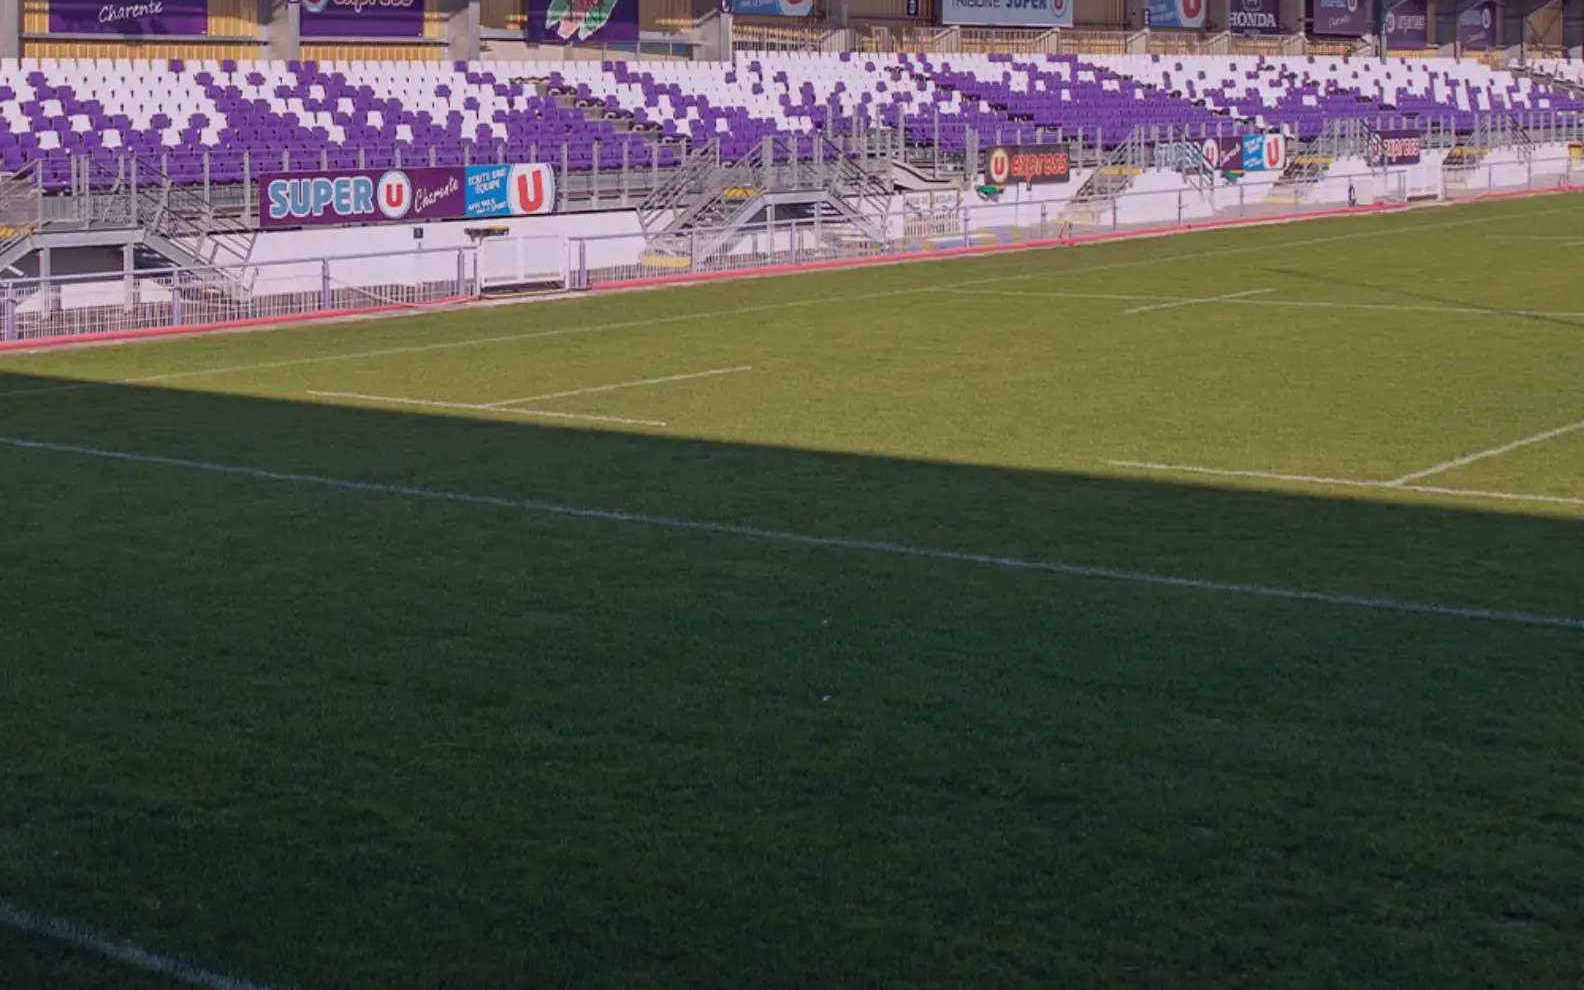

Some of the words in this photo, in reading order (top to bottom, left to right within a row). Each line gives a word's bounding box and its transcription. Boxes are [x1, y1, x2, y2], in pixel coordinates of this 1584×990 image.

[98, 0, 164, 23] Charente
[1229, 12, 1276, 27] HONDA
[1267, 138, 1280, 167] U
[994, 157, 1004, 176] U
[1011, 153, 1068, 182] express
[268, 176, 374, 219] SUPER
[386, 184, 403, 207] U
[518, 170, 544, 212] U
